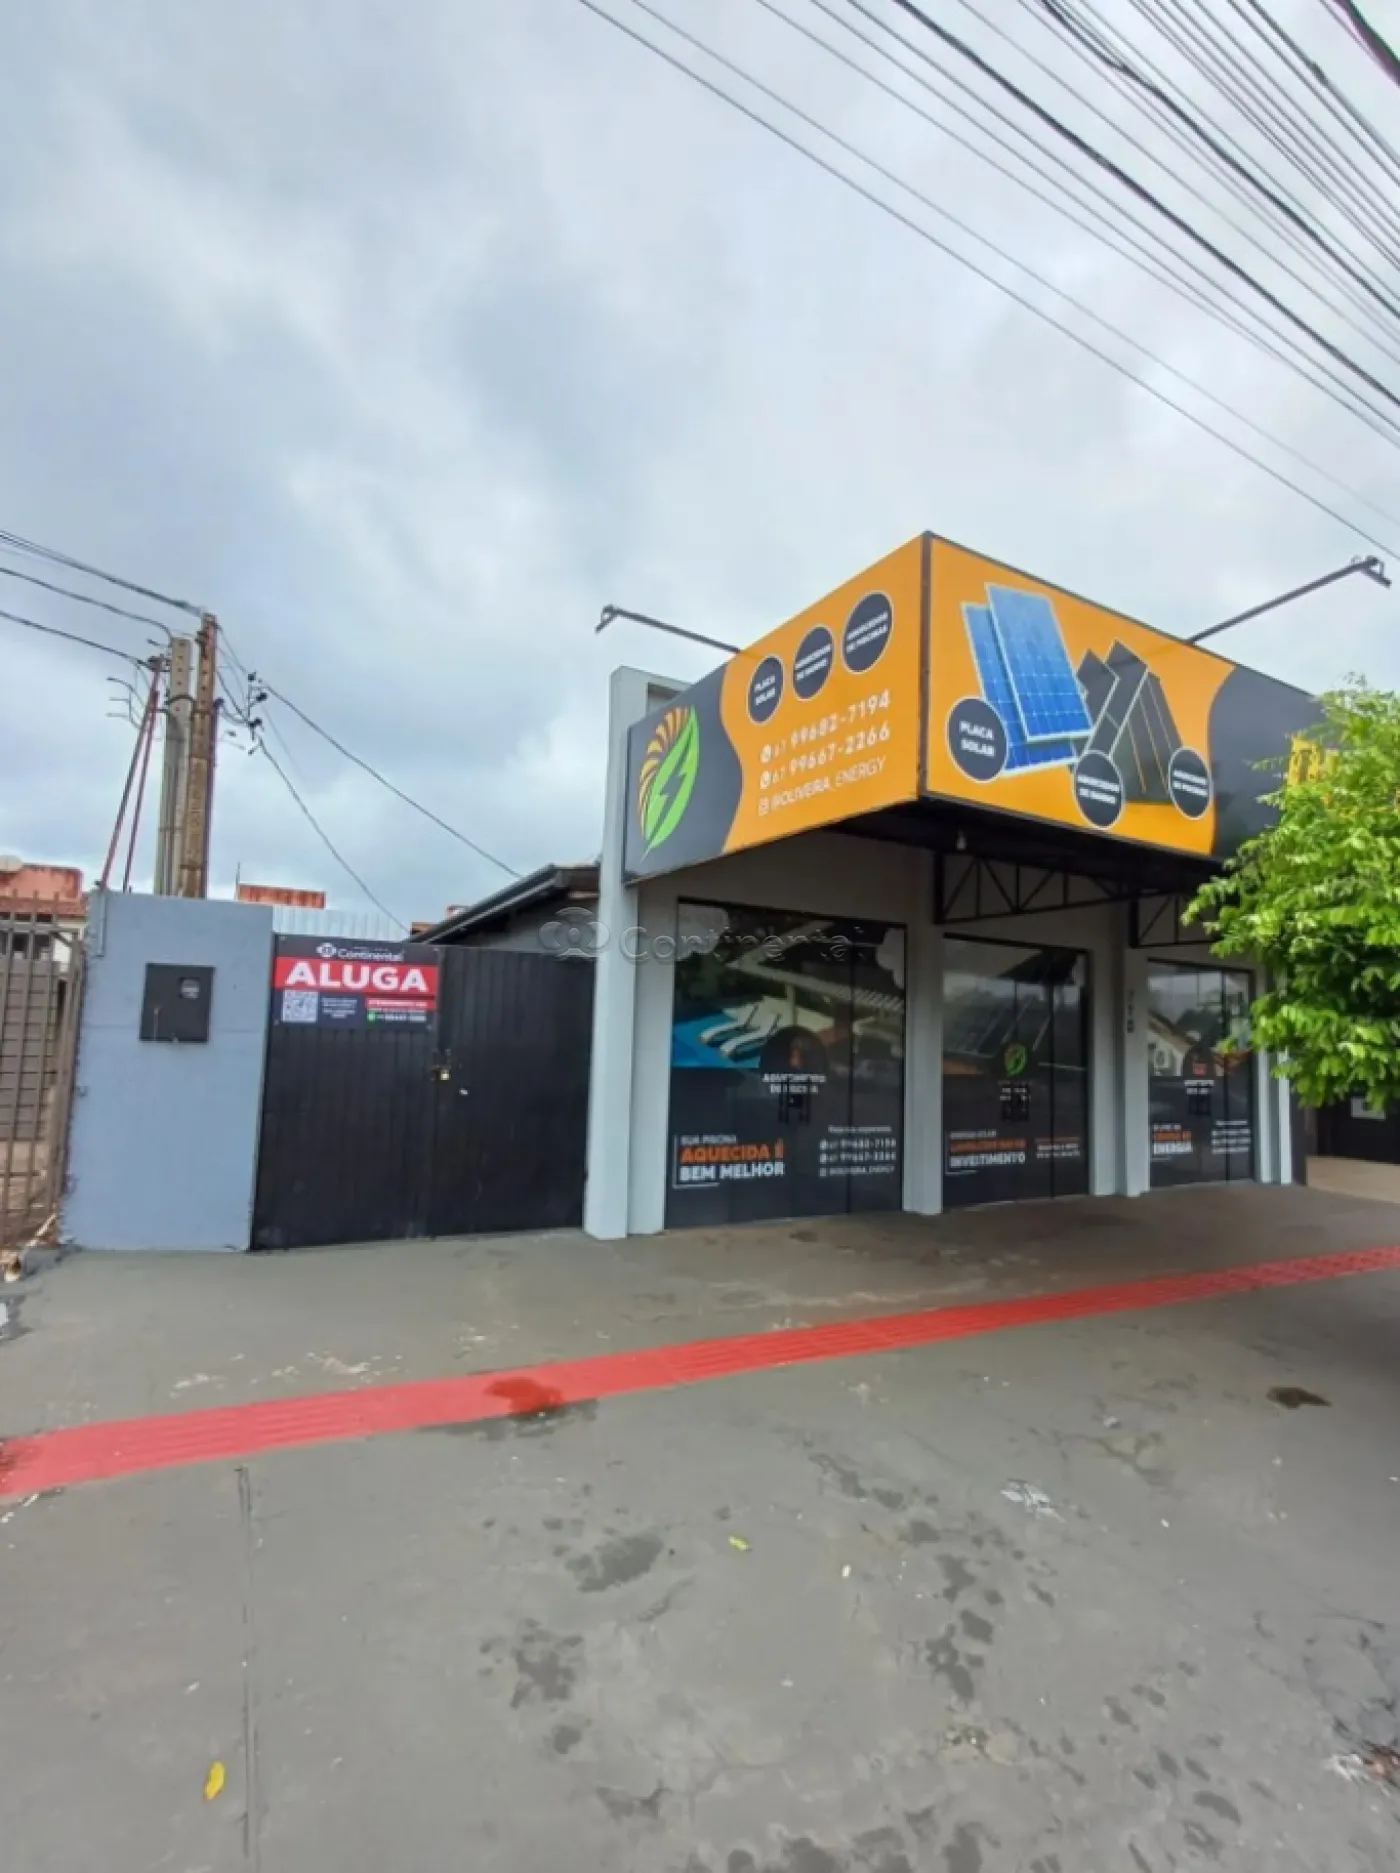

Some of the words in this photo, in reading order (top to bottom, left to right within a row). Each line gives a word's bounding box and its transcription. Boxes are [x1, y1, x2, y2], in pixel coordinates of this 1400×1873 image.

[958, 721, 994, 740] PLACA
[960, 739, 996, 757] SOLAR
[284, 960, 429, 993] ALUGA
[681, 1143, 770, 1163] AQUECIDA
[679, 1164, 716, 1182] BEM
[719, 1160, 786, 1179] MELHOR
